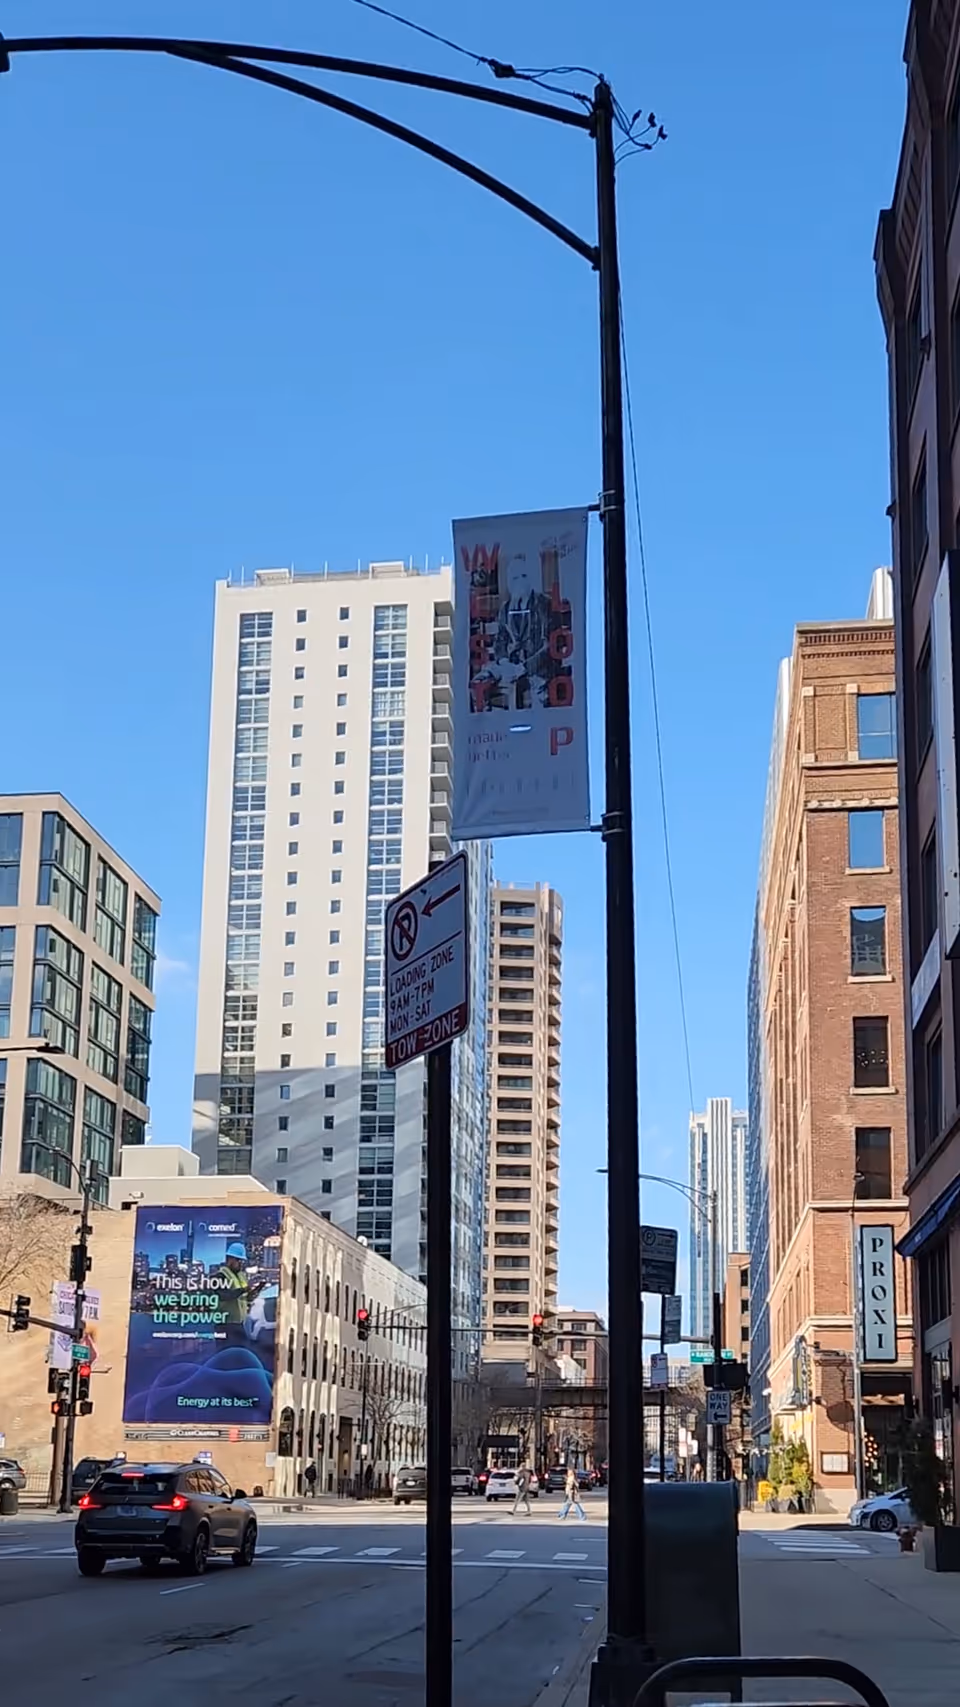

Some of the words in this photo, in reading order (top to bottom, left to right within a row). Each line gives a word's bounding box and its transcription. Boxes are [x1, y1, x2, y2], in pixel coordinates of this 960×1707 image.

[390, 962, 427, 997] LOADING
[430, 946, 454, 973] ZONE
[390, 982, 435, 1015] 9AM-7PM
[390, 1000, 432, 1035] MON-SAT
[156, 1223, 184, 1232] exelon
[155, 1274, 182, 1290] This
[186, 1274, 198, 1290] is
[199, 1274, 234, 1290] how
[154, 1293, 178, 1306] we
[180, 1291, 219, 1310] bring
[871, 1237, 887, 1349] PROXI
[153, 1308, 178, 1324] the
[180, 1311, 229, 1327] power
[177, 1396, 209, 1408] Energy
[210, 1397, 220, 1406] at
[221, 1397, 232, 1406] its
[709, 1392, 728, 1402] ONE
[709, 1402, 728, 1410] WAY
